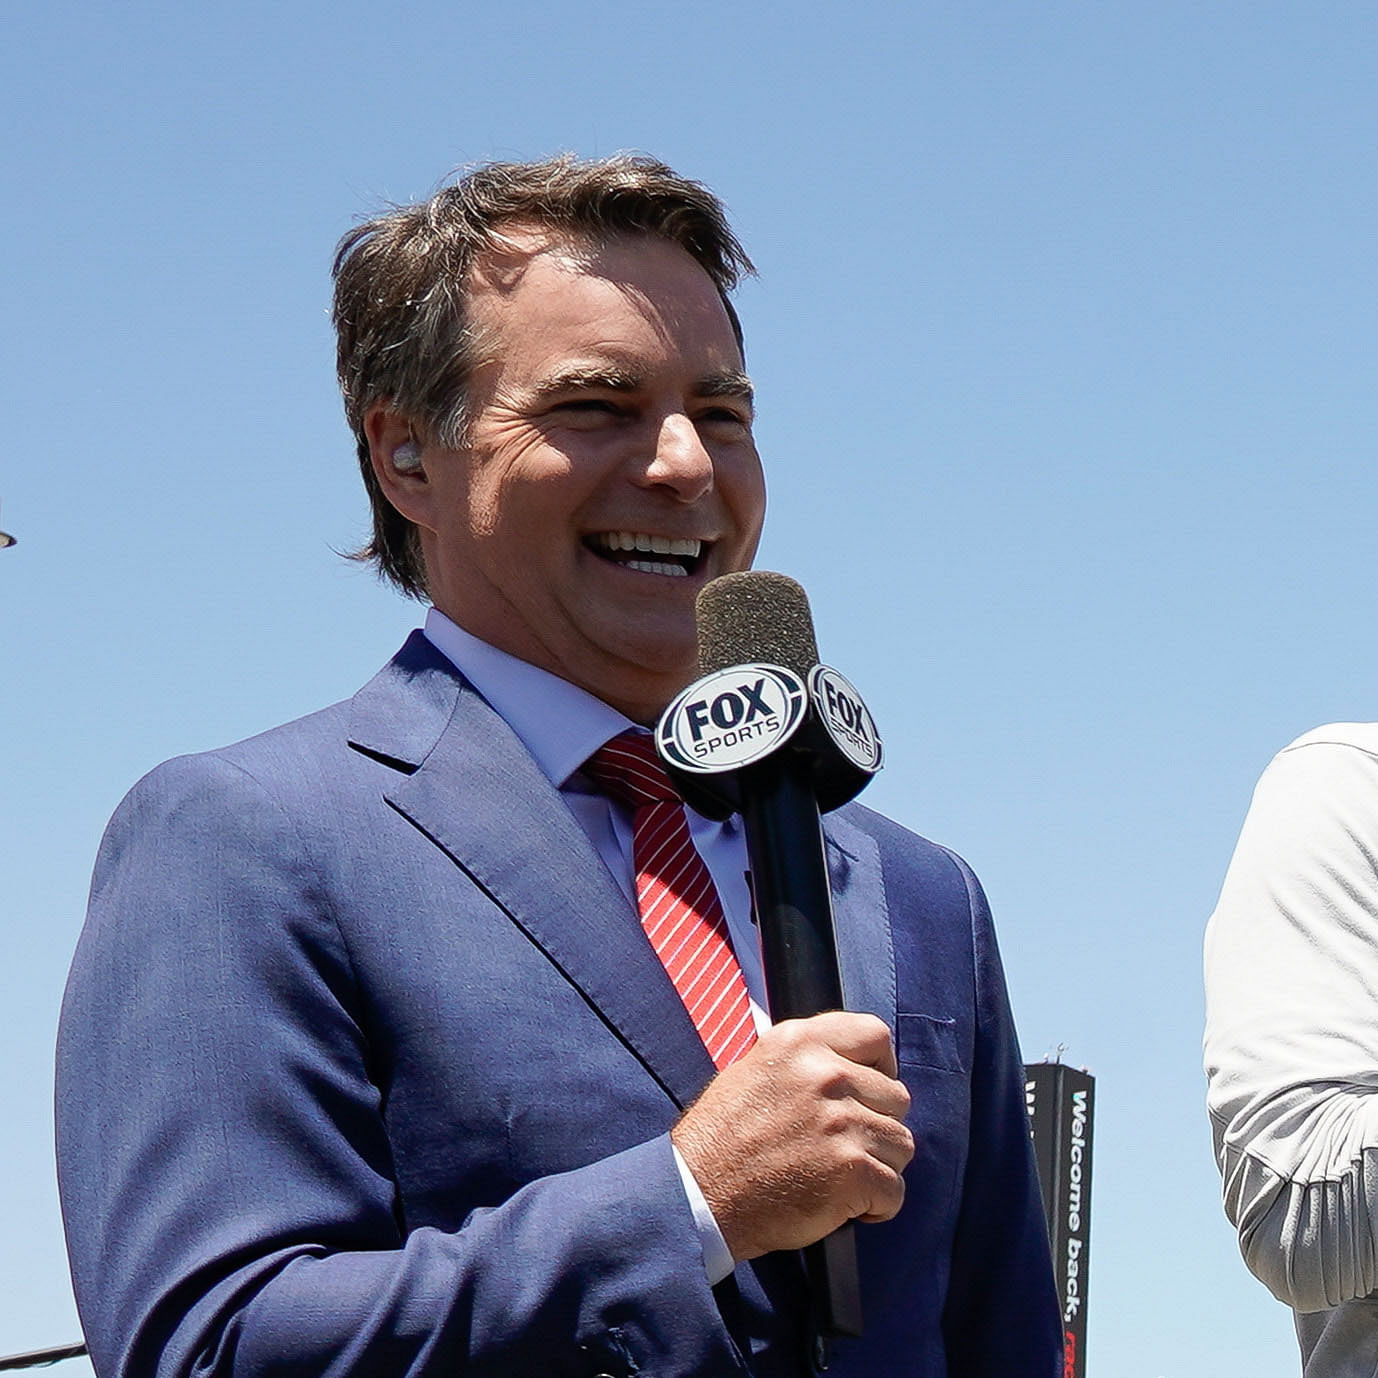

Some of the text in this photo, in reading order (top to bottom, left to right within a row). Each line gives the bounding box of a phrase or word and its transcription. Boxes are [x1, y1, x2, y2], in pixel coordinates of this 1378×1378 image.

[685, 678, 776, 742] FOX
[694, 715, 780, 758] SPORTS
[823, 678, 870, 744] FOX
[830, 718, 874, 758] SPORTS
[1067, 1089, 1087, 1234] Welcome
